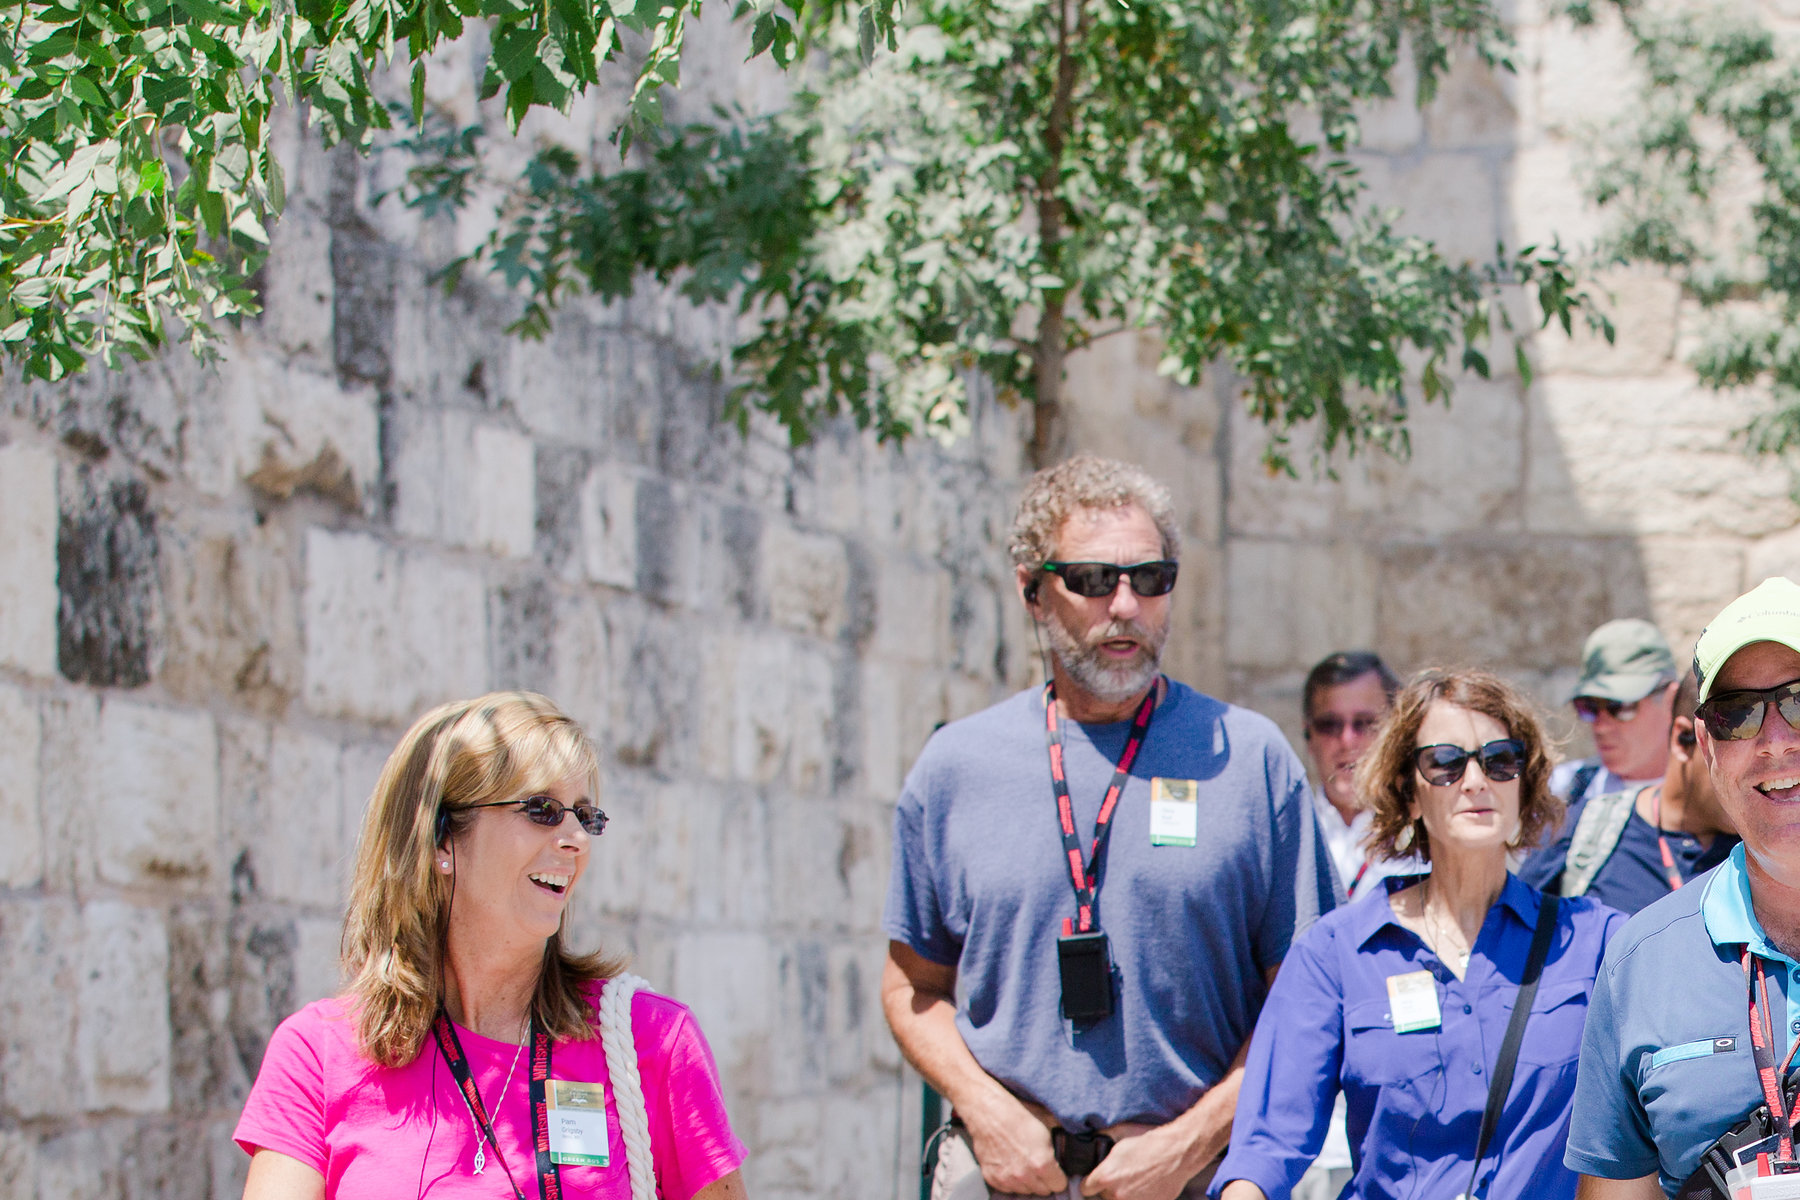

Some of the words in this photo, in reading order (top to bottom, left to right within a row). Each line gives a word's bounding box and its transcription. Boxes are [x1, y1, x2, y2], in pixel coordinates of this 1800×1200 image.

[532, 1033, 548, 1081] Whisper
[463, 1077, 488, 1126] Whisper
[1759, 1067, 1784, 1118] Whisper
[536, 1102, 549, 1153] Whisper
